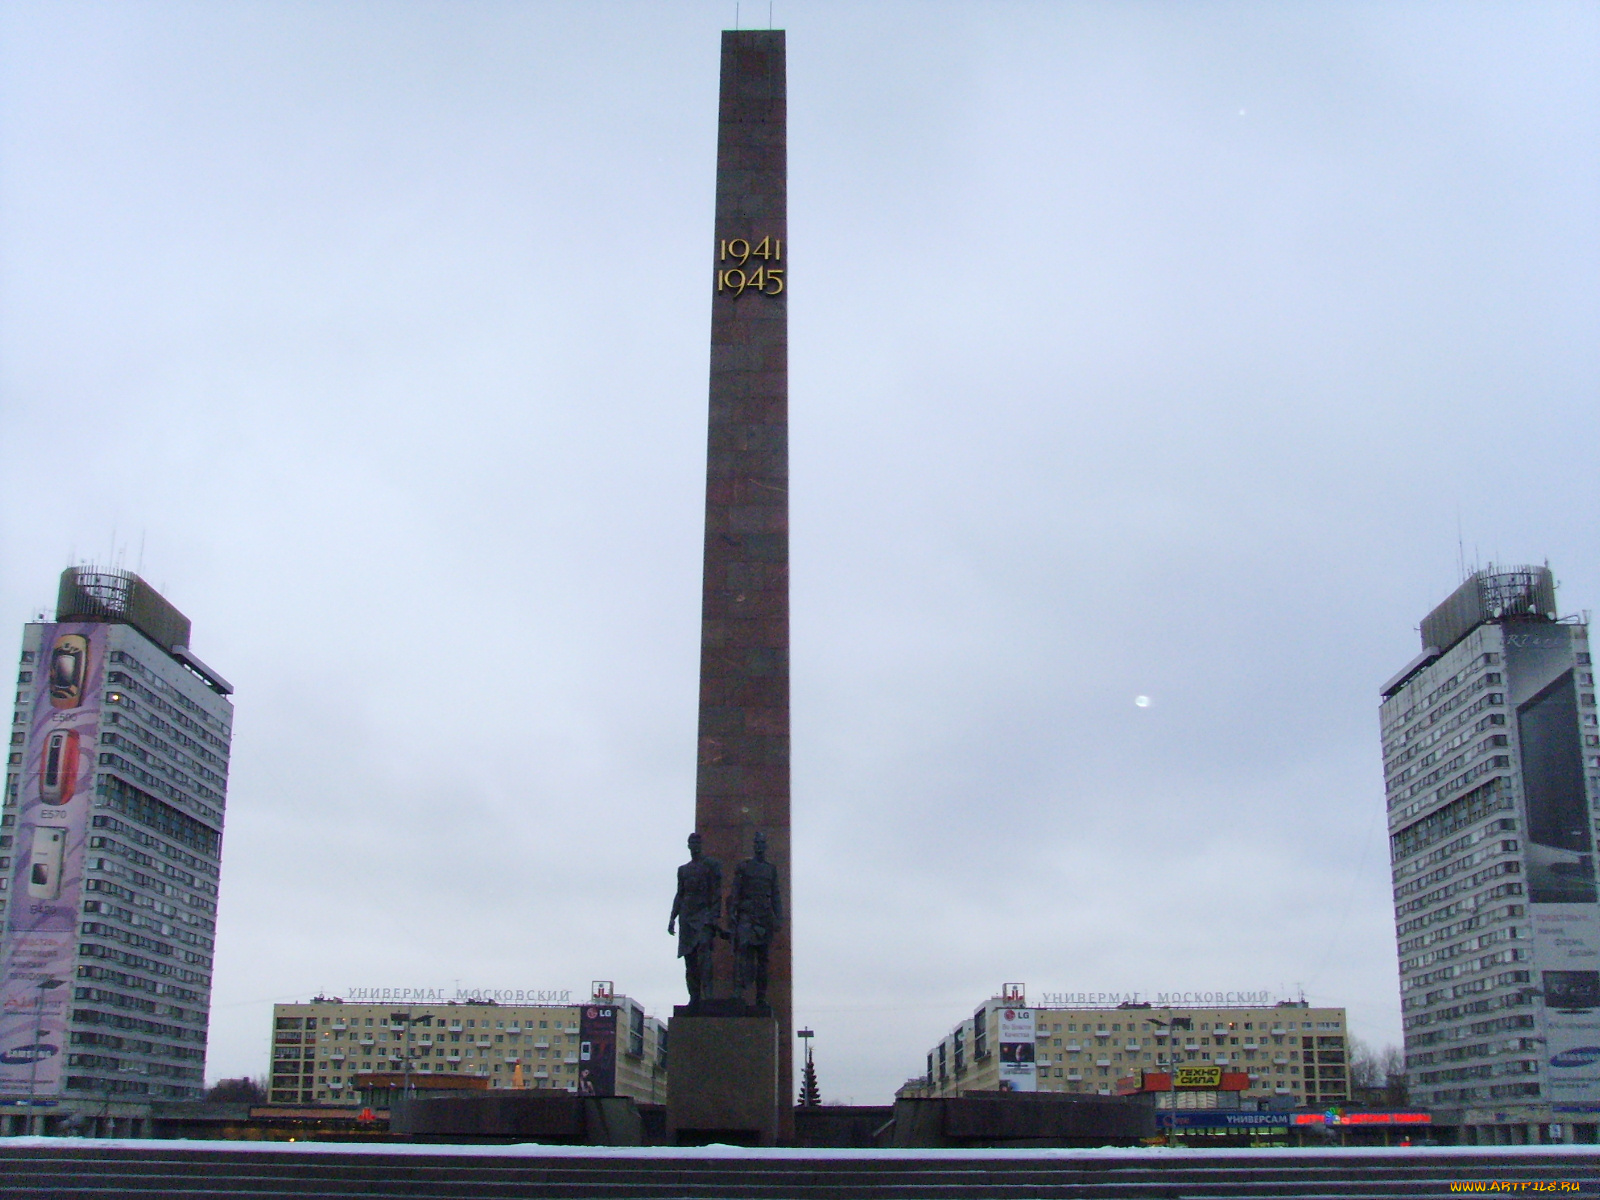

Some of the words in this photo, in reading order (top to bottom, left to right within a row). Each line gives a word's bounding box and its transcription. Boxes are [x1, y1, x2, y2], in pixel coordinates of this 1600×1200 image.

[721, 235, 780, 266] 1941
[718, 265, 784, 298] 1945
[348, 988, 445, 999] УНИВЕРМАГ
[456, 989, 572, 1001] МОСКОВСКИЙ
[1043, 992, 1140, 1003] УНИВЕРМАГ
[1157, 990, 1271, 1003] МОСКОВСКИЙ
[600, 1009, 612, 1017] LG
[1179, 1068, 1219, 1076] ТЕХНО
[1226, 1115, 1288, 1124] УНИВЕРСАМ
